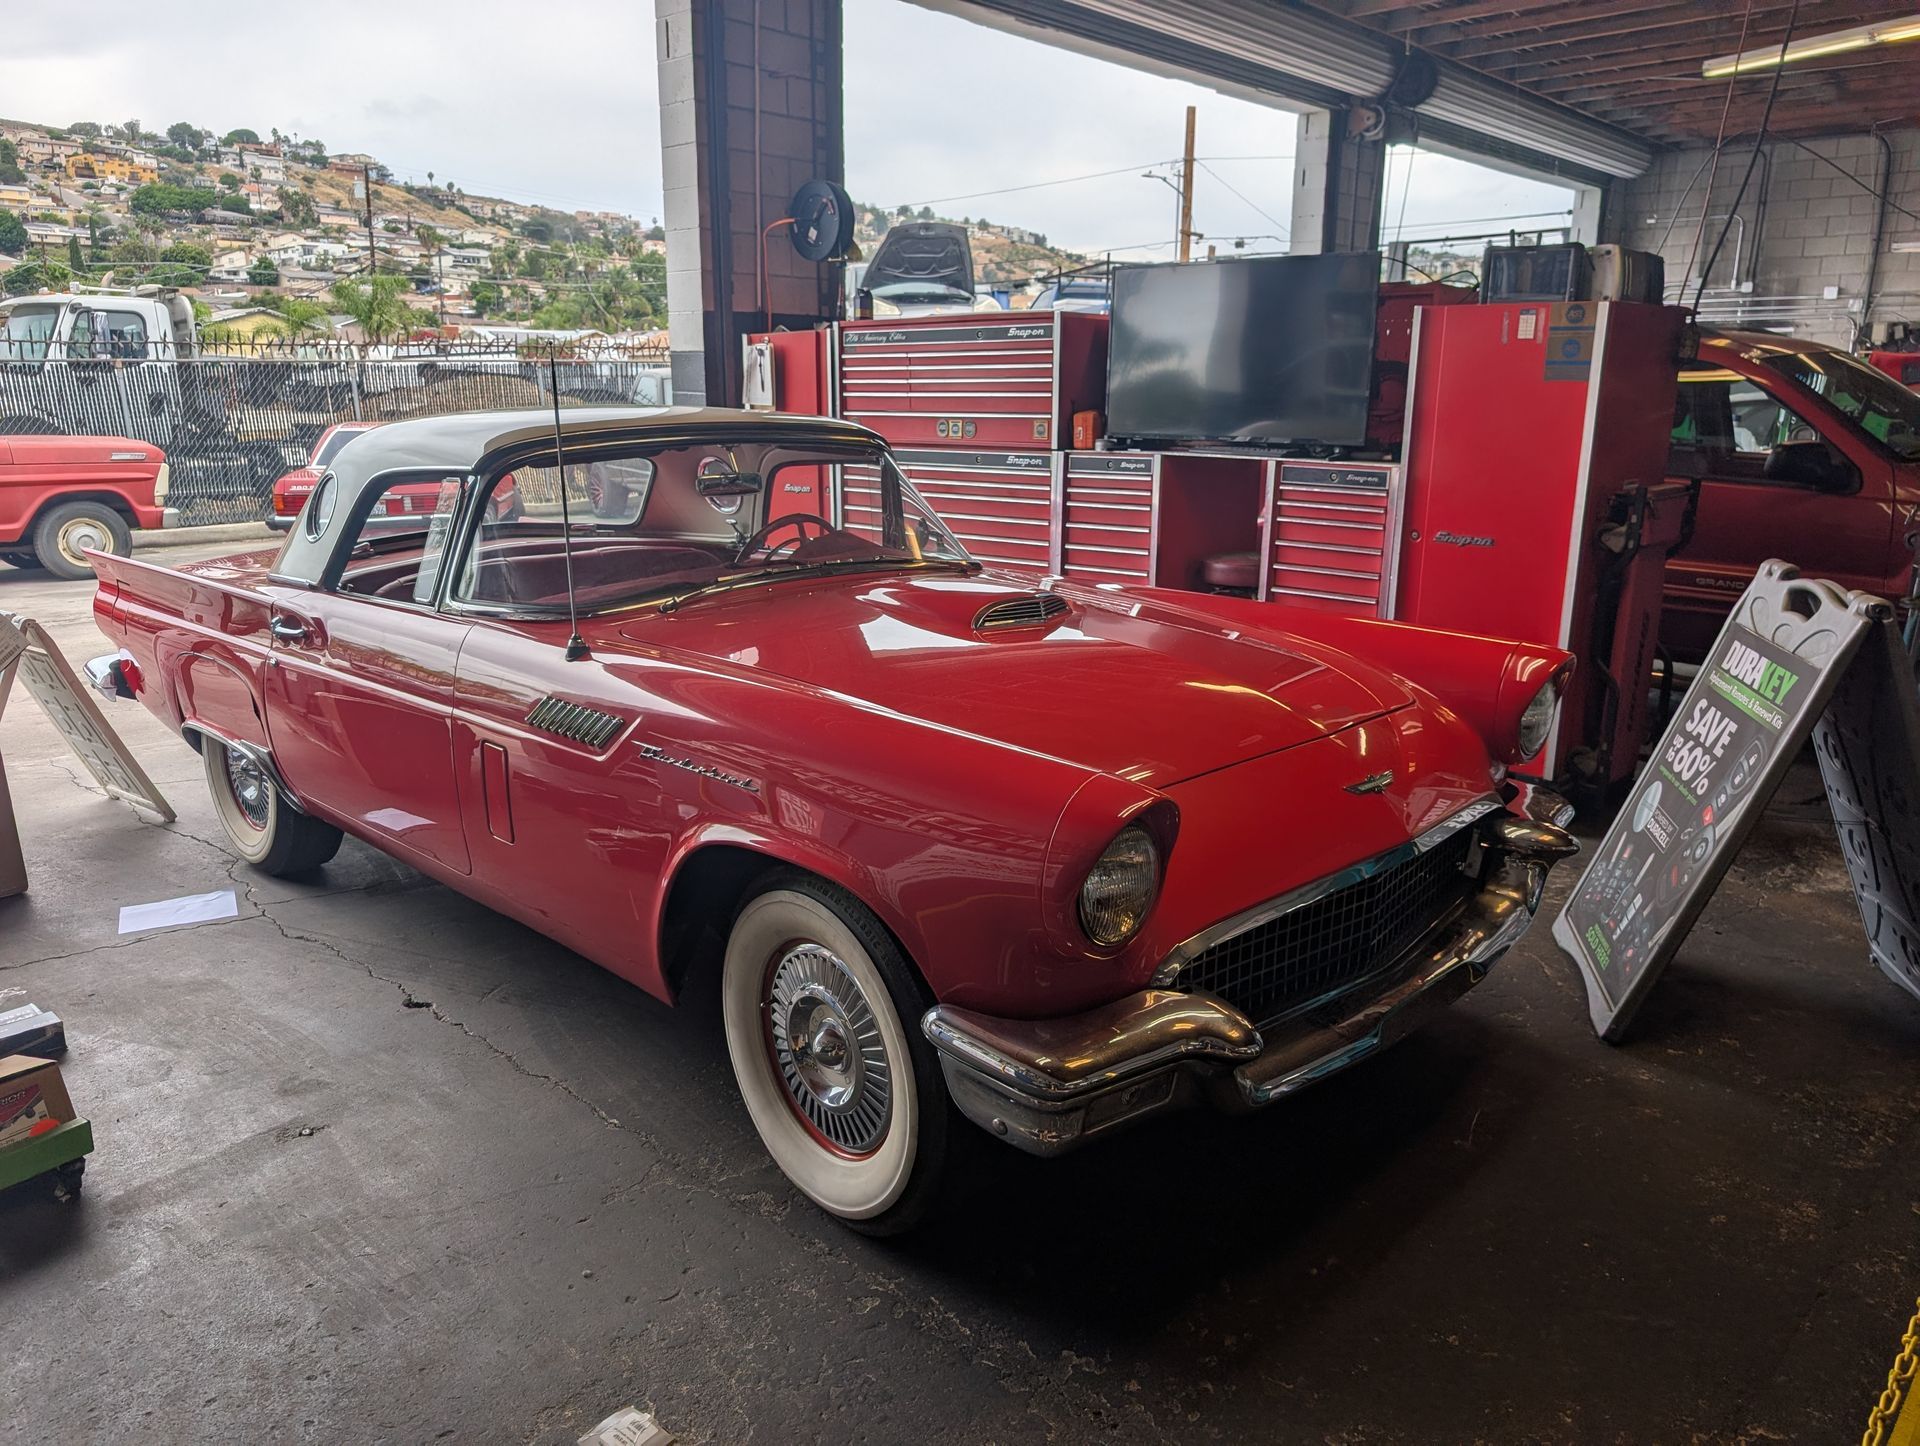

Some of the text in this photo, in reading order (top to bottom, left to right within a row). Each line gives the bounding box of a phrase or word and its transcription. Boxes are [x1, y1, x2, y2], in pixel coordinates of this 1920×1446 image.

[1007, 327, 1045, 338] Snap-on
[1006, 455, 1043, 467] Snap-on
[1119, 461, 1146, 470] Snap-on
[1346, 473, 1379, 484] Snap-on
[783, 483, 812, 495] Snap-on
[1433, 530, 1496, 547] Snap-on
[1695, 577, 1746, 589] GRAND
[1720, 640, 1799, 705] DURAKEY
[1747, 697, 1755, 708] &
[1752, 700, 1776, 722] Renewal
[1772, 713, 1783, 730] Kits
[1685, 698, 1738, 758] SAVE
[631, 740, 759, 792] Thunderbird
[1665, 733, 1717, 796] up to 60%
[1646, 817, 1671, 848] DURACELL
